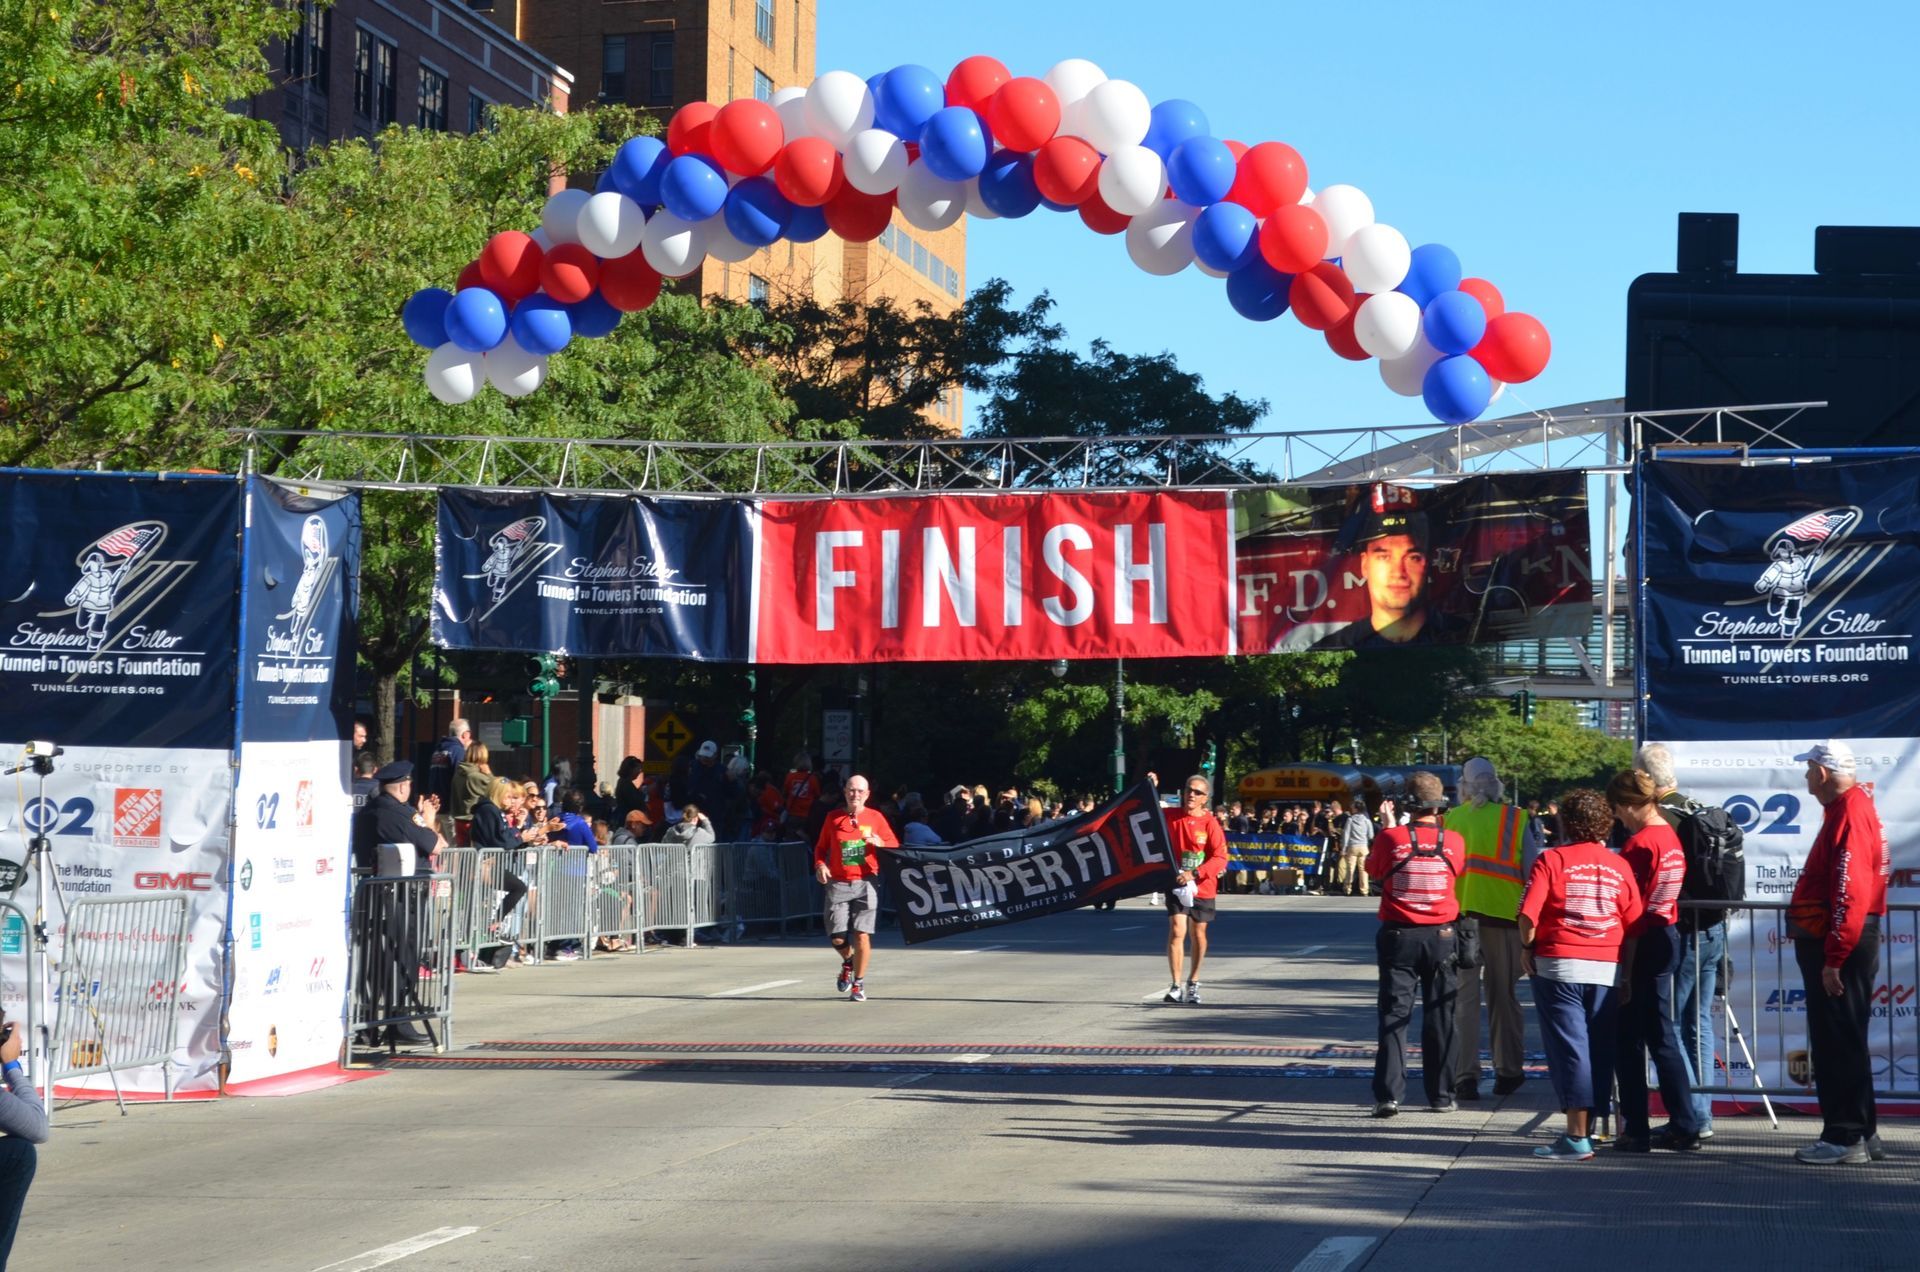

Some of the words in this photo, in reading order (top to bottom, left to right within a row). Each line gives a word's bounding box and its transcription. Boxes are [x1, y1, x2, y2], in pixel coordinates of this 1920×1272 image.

[565, 557, 628, 584] Stephen
[816, 523, 1167, 631] FINISH
[536, 581, 579, 601] Tunnel
[591, 586, 631, 602] Towers
[633, 585, 707, 606] Foundation
[574, 607, 663, 615] TUNNEL2TOWERS.ORG
[1695, 611, 1781, 643] Stephen
[1820, 610, 1886, 635] Siller
[10, 622, 87, 653] Stephen
[123, 625, 183, 649] Siller
[1681, 645, 1737, 664] Tunnel
[1751, 645, 1811, 663] Towers
[1815, 643, 1908, 662] Foundation
[0, 653, 46, 672] Tunnel
[59, 656, 113, 675] Towers
[117, 656, 201, 676] Foundation
[1722, 674, 1869, 684] TUNNEL2TOWERS.ORG
[32, 684, 164, 695] TUNNEL2TOWERS.ORG
[73, 763, 162, 773] SUPPORTED
[170, 764, 189, 773] BY
[1690, 758, 1766, 767] PROUDLY
[119, 792, 139, 812] THE
[55, 797, 94, 835] 2
[114, 789, 162, 836] HOME
[132, 808, 162, 837] DEPOT
[1759, 793, 1801, 834] 2
[115, 838, 159, 847] FOUNDATION
[1227, 842, 1263, 850] AVERIAN
[1288, 843, 1320, 852] SCHOO
[73, 864, 112, 879] Marcus
[901, 850, 1073, 916] SEMPER
[1066, 811, 1165, 882] FIVE
[1756, 865, 1777, 878] The
[1780, 865, 1804, 878] Mar
[134, 872, 212, 890] GMC
[1756, 881, 1794, 893] Found
[915, 915, 959, 929] MARINE
[964, 909, 1002, 923] CORPS
[1006, 894, 1058, 914] CHARITY
[1062, 891, 1077, 901] 5K
[1765, 989, 1807, 1004] AP
[1870, 1006, 1919, 1018] OHAW
